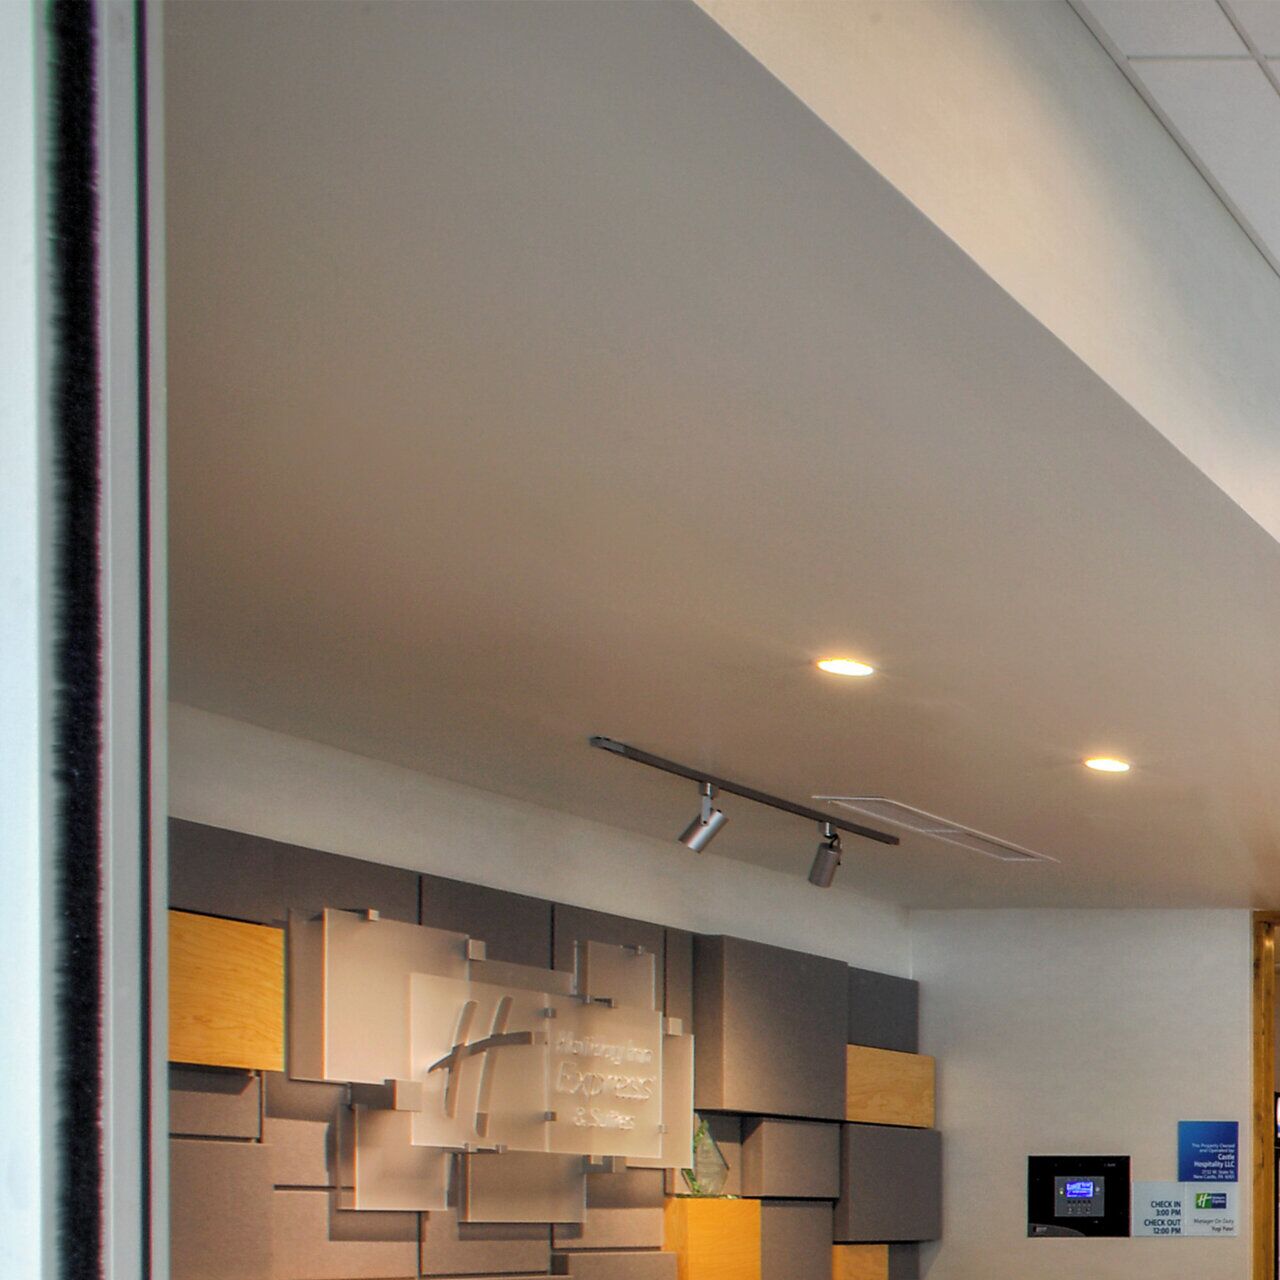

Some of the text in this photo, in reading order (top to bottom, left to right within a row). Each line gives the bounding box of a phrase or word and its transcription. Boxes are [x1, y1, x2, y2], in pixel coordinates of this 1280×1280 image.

[556, 1030, 625, 1065] Holiday
[590, 1107, 636, 1130] Suites
[1193, 1160, 1235, 1169] Hospitality LLC
[1150, 1200, 1181, 1208] CHECK IN
[1156, 1208, 1181, 1216] 3:00 PM
